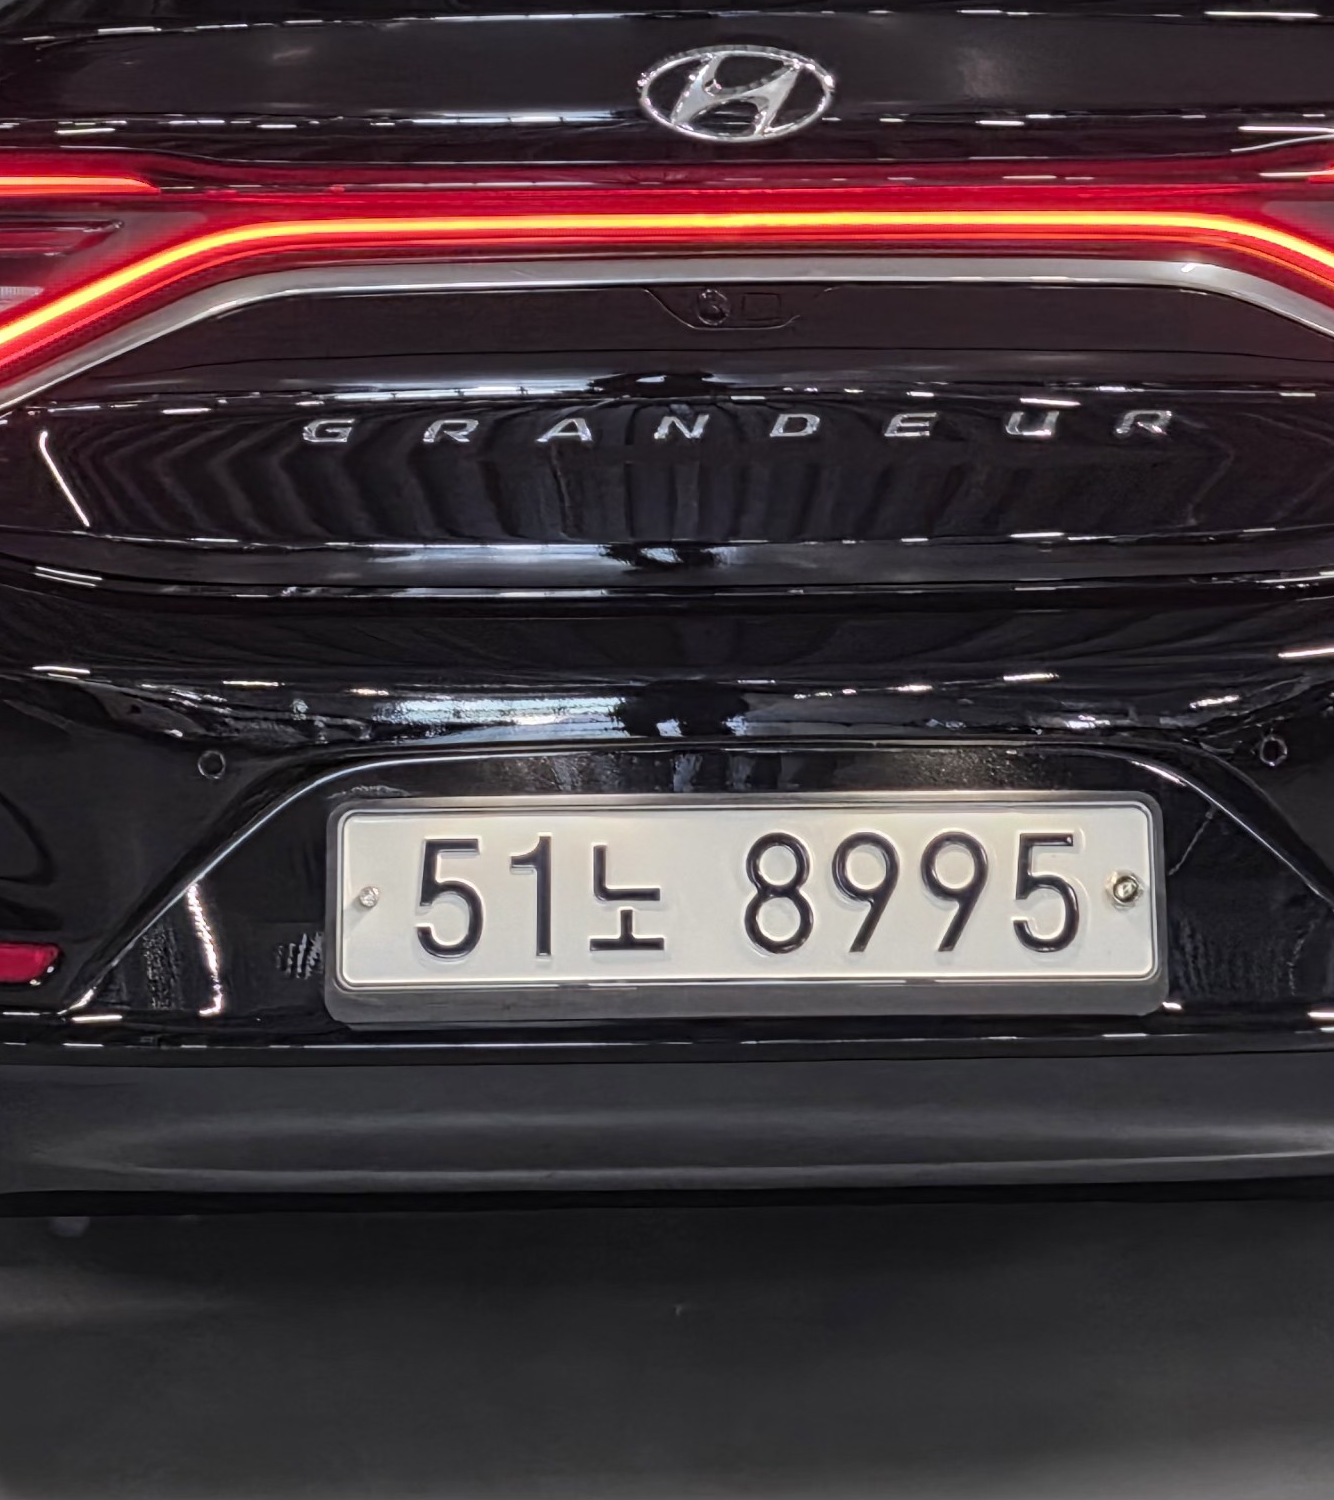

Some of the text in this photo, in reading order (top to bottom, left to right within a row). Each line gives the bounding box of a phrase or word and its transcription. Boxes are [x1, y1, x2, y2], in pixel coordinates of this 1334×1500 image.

[302, 409, 1172, 443] GRANDEUR
[416, 830, 1080, 960] 51노 8995
